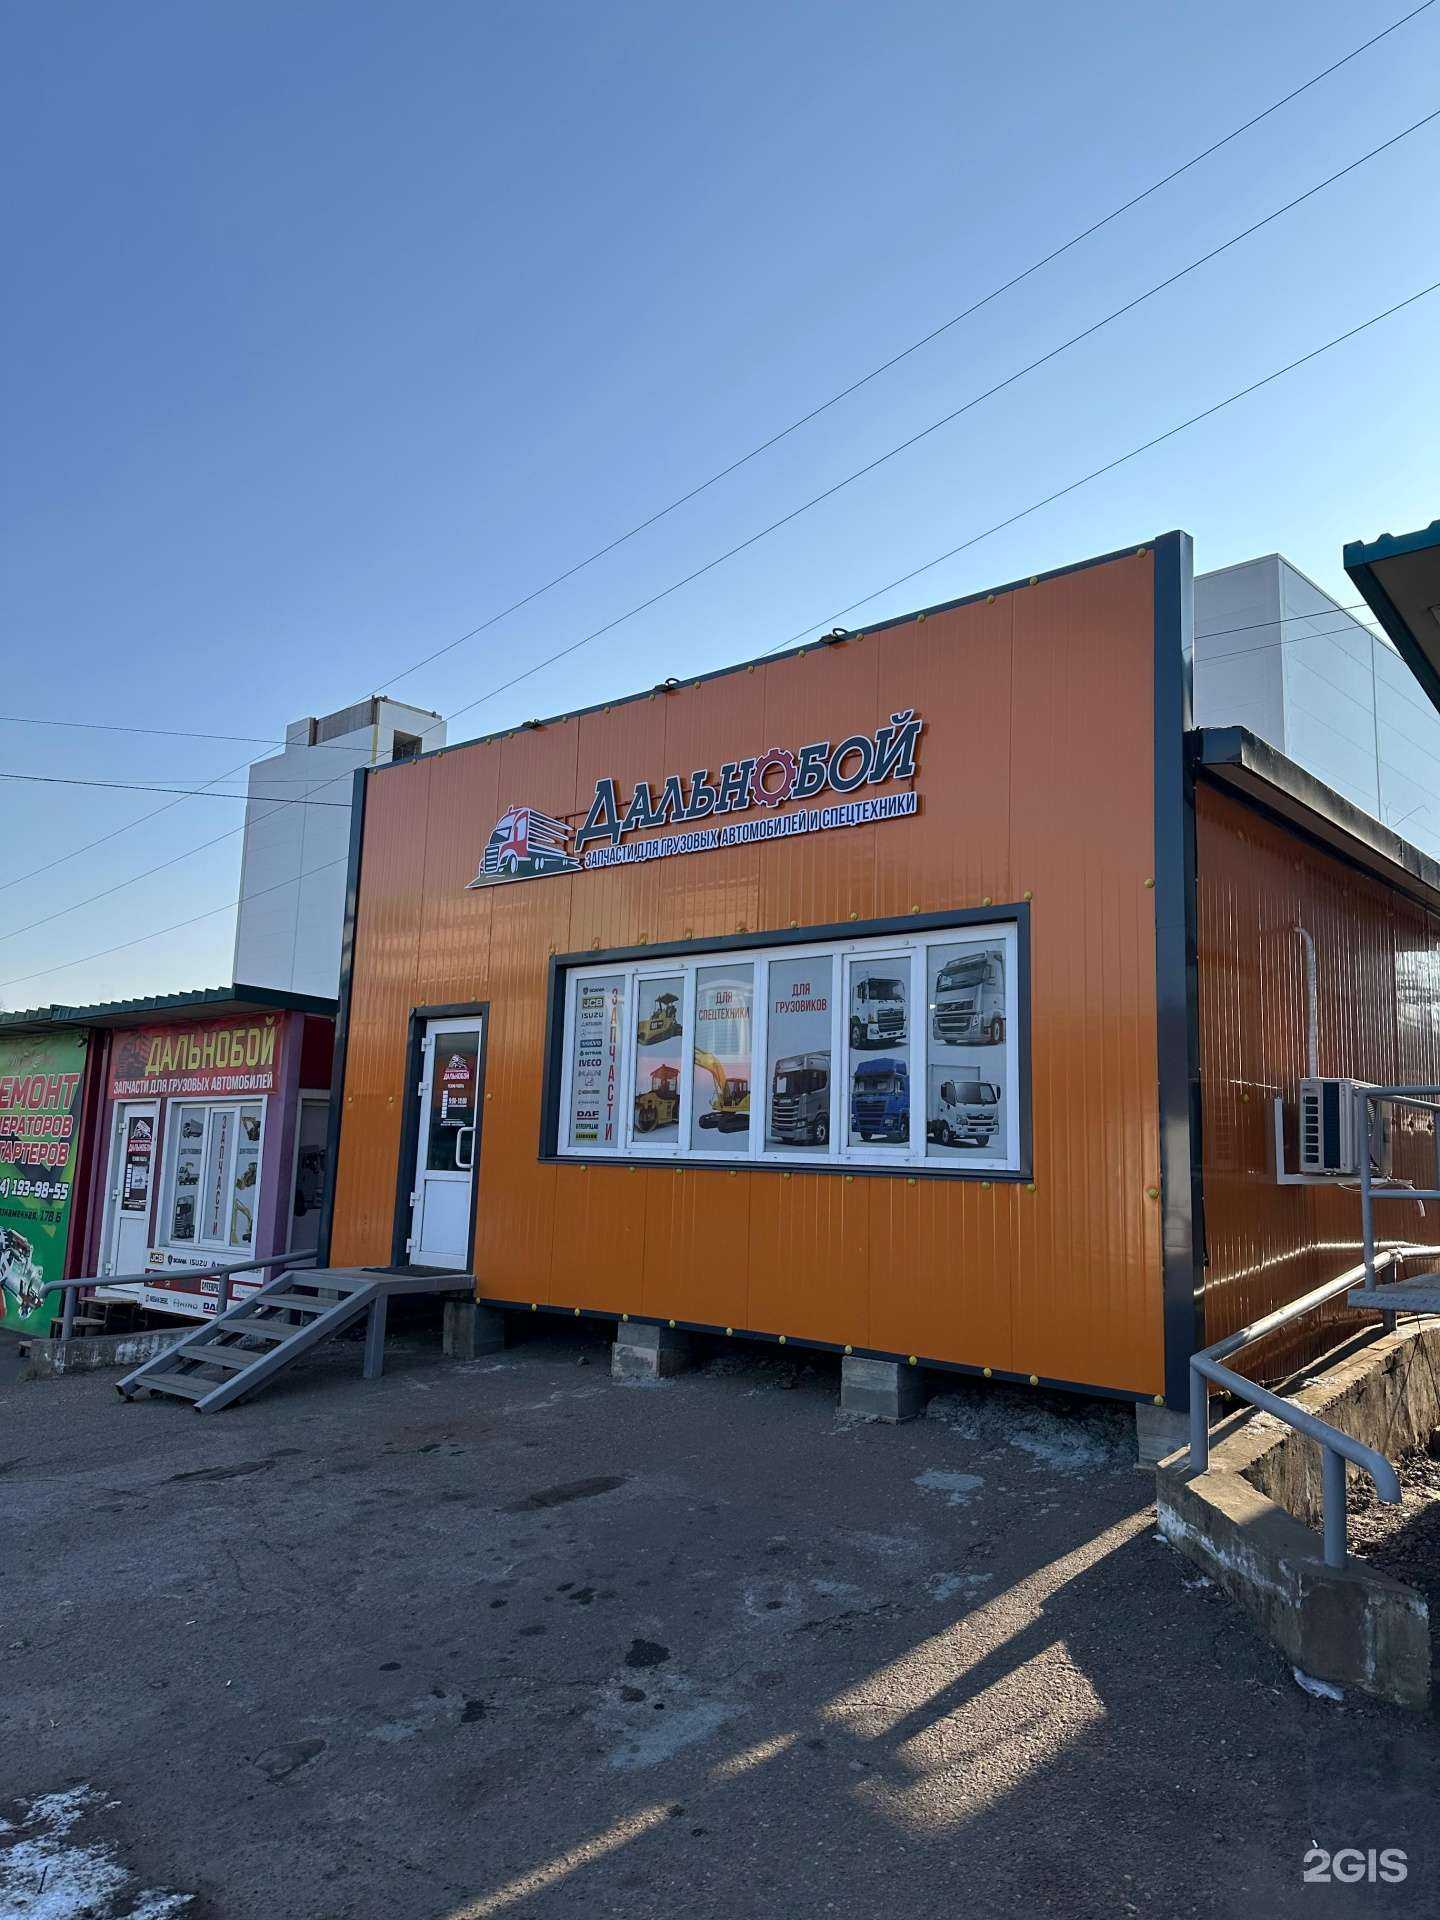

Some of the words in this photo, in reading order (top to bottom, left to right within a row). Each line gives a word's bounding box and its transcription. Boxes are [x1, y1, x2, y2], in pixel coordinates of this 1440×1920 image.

[574, 709, 922, 852] ДАЛЬНОБОЙ
[585, 844, 636, 868] ЗАПЧАСТИ
[636, 836, 660, 862] ДЛЯ
[660, 828, 719, 856] ГРУЗОВЫХ
[721, 809, 808, 846] АВТОМОБИЛЕЙ
[809, 810, 820, 830] И
[822, 792, 917, 828] СПЕЦТЕХНИКИ
[792, 983, 811, 996] ДЛЯ
[584, 998, 603, 1007] JCB
[716, 992, 732, 1004] ДЛЯ
[776, 998, 827, 1013] ГРУЗОВИКОВ
[699, 1007, 751, 1020] СПЕЦТЕХНИКИ
[145, 1016, 275, 1076] ДАЛЬНОБОЙ
[579, 1059, 601, 1067] IVECO
[605, 988, 618, 1141] ЗАПЧАСТИ
[114, 1080, 149, 1094] ЗАПЧАСТИ
[150, 1078, 167, 1094] ДЛЯ
[168, 1075, 209, 1092] ГРУЗОВЫХ
[211, 1071, 273, 1091] АВТОМОБИЛЕЙ
[213, 1116, 226, 1236] ЗАПЧАСТИ
[12, 1179, 68, 1200] 193-98-55
[151, 1254, 164, 1262] JCB
[190, 1259, 208, 1267] ISUZU
[204, 1303, 218, 1311] DA
